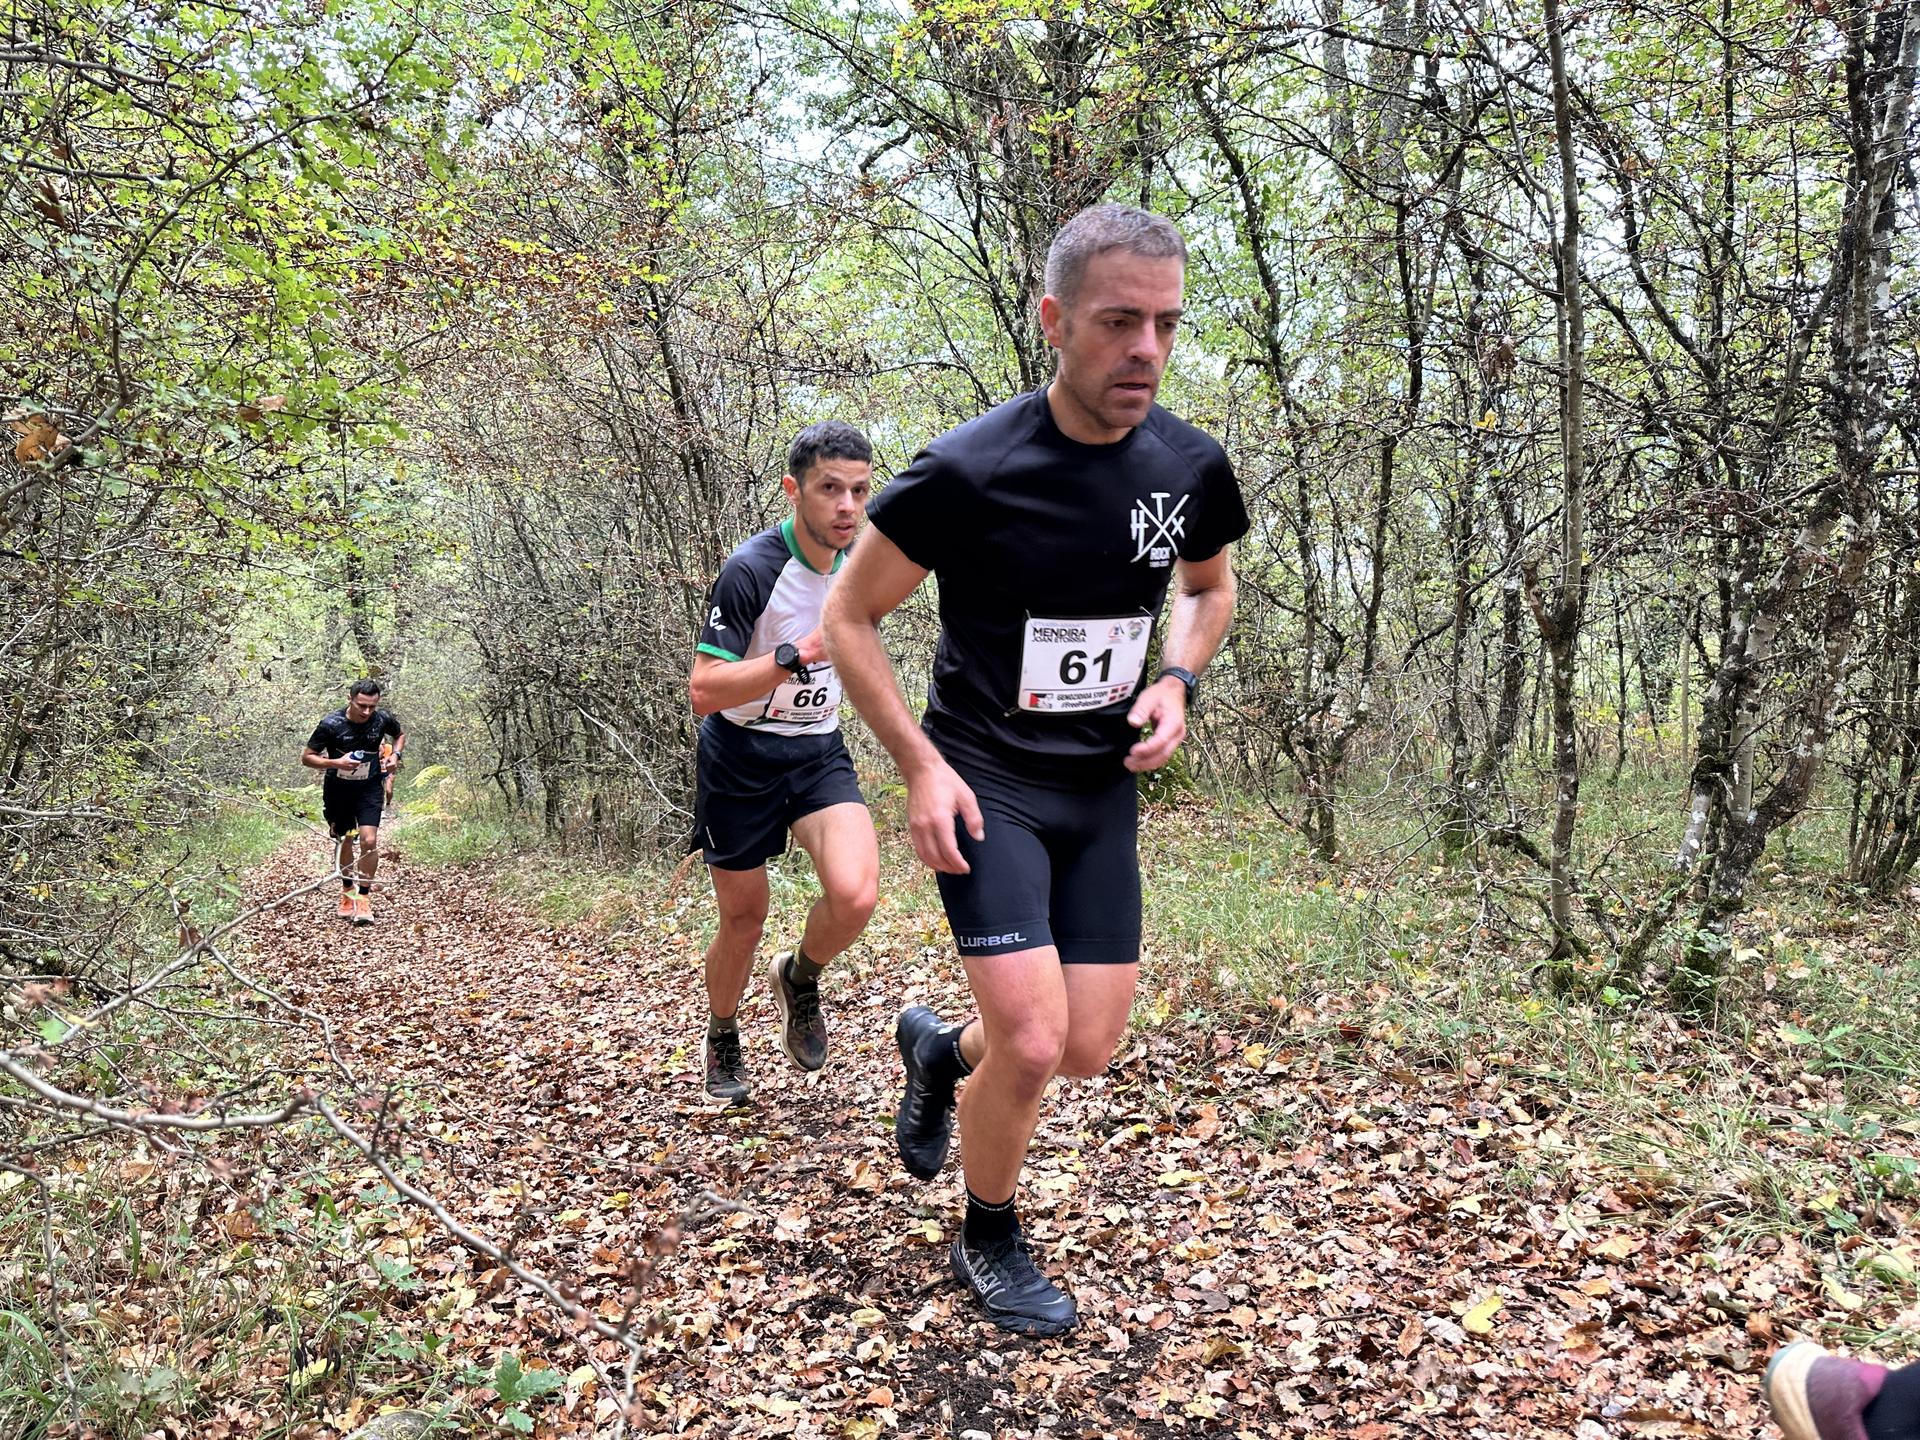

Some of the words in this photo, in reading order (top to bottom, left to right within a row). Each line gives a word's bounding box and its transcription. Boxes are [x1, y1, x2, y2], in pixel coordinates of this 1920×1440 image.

[1032, 627, 1087, 638] MENDIRA
[1059, 648, 1113, 685] 61
[793, 686, 828, 708] 66
[960, 932, 1027, 947] LURBEL
